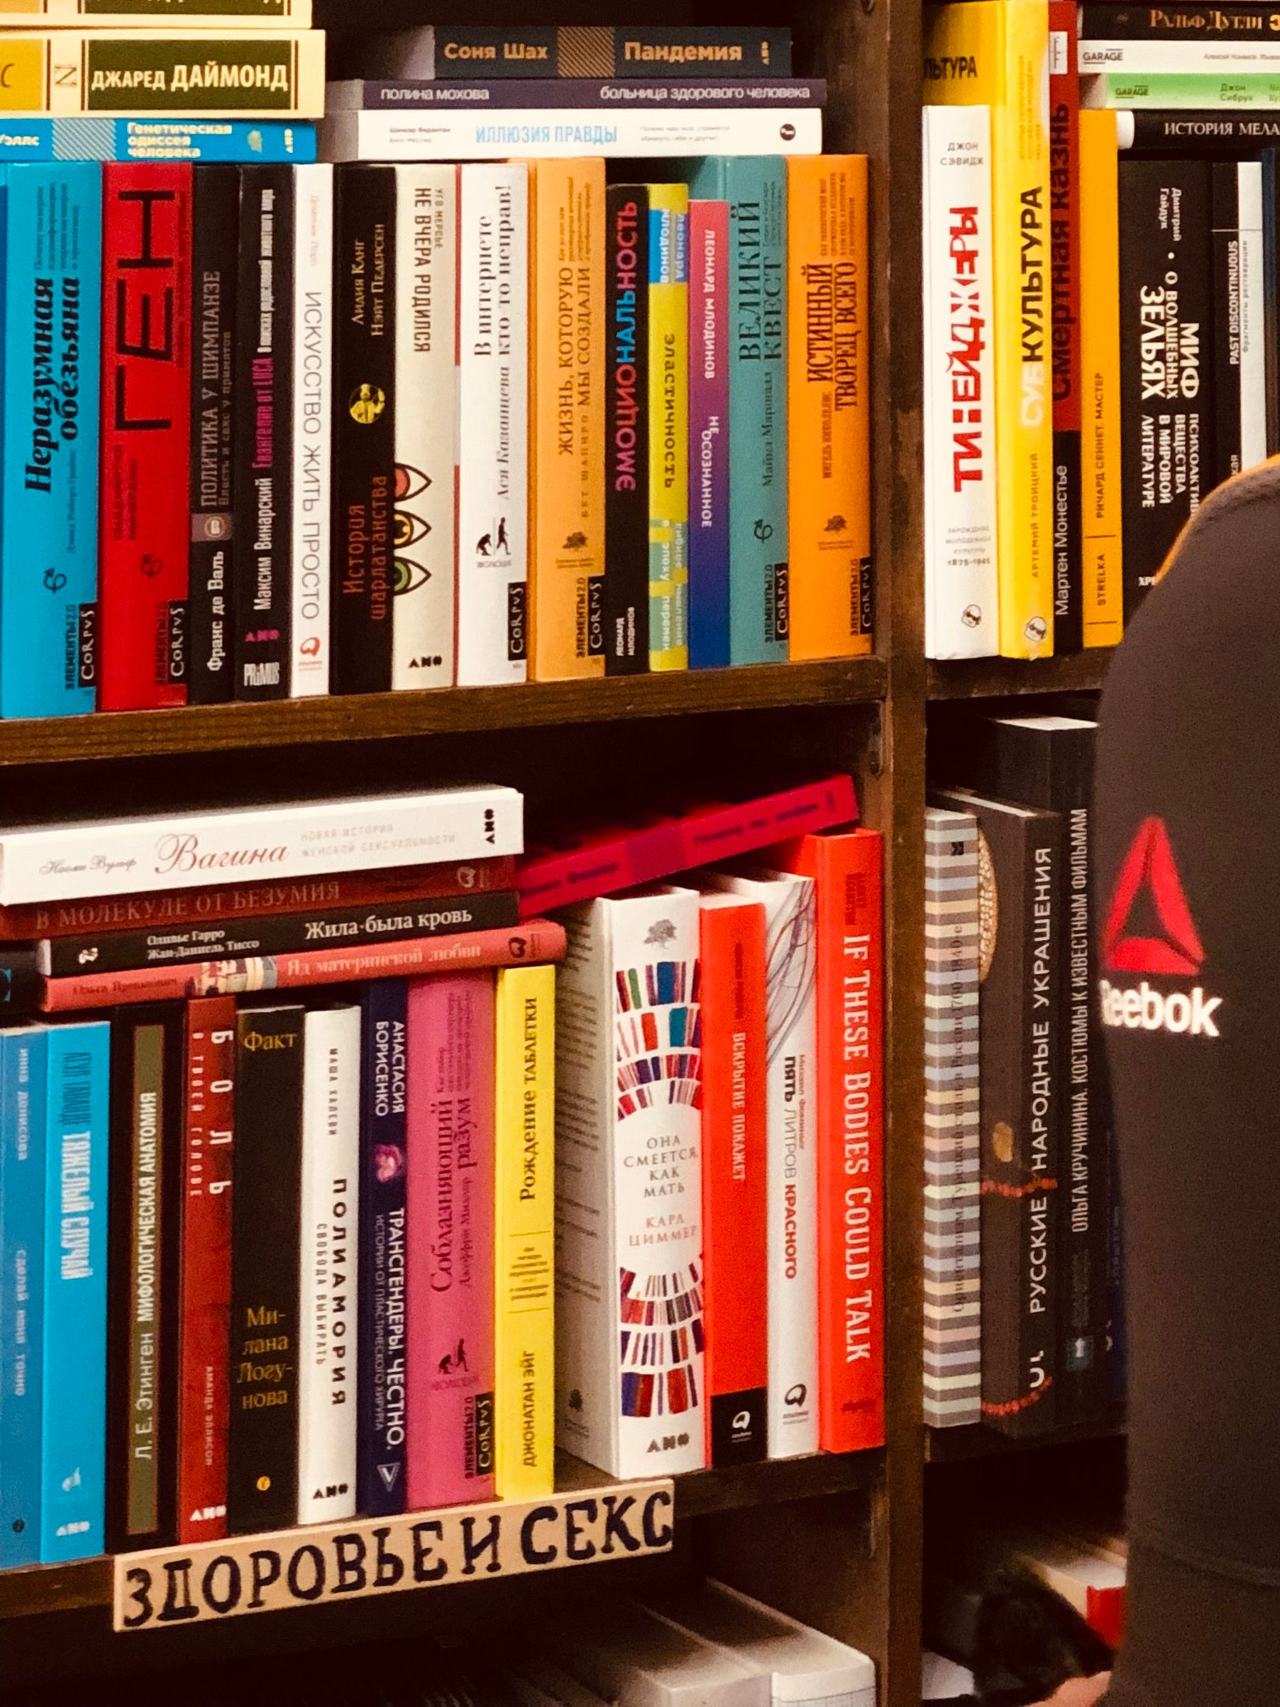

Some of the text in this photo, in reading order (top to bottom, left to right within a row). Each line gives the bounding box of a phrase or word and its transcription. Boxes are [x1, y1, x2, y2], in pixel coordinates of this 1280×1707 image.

[91, 61, 288, 91] ДЖАРЕД ДАЙМОНД
[380, 85, 810, 103] полина мохова больница здорового человека
[444, 42, 742, 62] Соня Шах Пандемия
[1164, 121, 1234, 137] ИСТОРИЯ
[113, 189, 176, 431] ГЕН
[703, 229, 716, 380] ЛЕОНАРД МЛОДИНОВ
[736, 201, 761, 362] ВЕЛИКИЙ
[762, 261, 783, 361] КВЕСТ
[806, 263, 833, 384] ИСТИННЫЙ
[24, 276, 56, 496] Неразумная
[59, 276, 81, 442] обезьяна
[614, 201, 638, 493] ЭМОЦИОНАЛЬНОСТЬ
[834, 262, 858, 412] ТВОРЕЦ ВСЕГО
[1140, 285, 1165, 401] ЗЕЛЬЯХ
[1180, 322, 1200, 399] МИФ
[302, 291, 323, 621] ИСКУССТВО ЖИТЬ ПРОСТО
[254, 477, 272, 611] Максим Винарский
[344, 503, 365, 594] История
[370, 475, 387, 620] шарлатанства
[154, 833, 289, 874] Вагина
[305, 907, 472, 940] Жила-была кровь
[843, 933, 870, 966] IF
[243, 1029, 297, 1056] Факт
[842, 971, 870, 1063] THESE
[518, 997, 539, 1202] Рождение ТАБЛЕТКИ
[843, 1071, 870, 1176] BODIES
[1028, 846, 1053, 1315] РУССКИЕ НАРОДНЫЕ УКРАШЕНИЯ
[642, 1181, 686, 1199] МАТЬ
[646, 1133, 683, 1151] ОНА
[648, 1167, 682, 1182] КАК
[783, 1055, 798, 1280] ПЯТЬ ЛИТРОВ КРАСНОГО
[137, 1091, 159, 1323] МИФОЛОГИЧЕСКАЯ АНАТОМИЯ
[628, 1227, 699, 1247] ЦИММЕР
[644, 1214, 686, 1229] КАРЛ
[842, 1186, 872, 1281] COULD
[332, 1178, 348, 1407] ПОЛИАМОРИЯ
[843, 1290, 874, 1364] TALK
[123, 1491, 673, 1629] ЗДОРОВЬЕ И СЕКС
